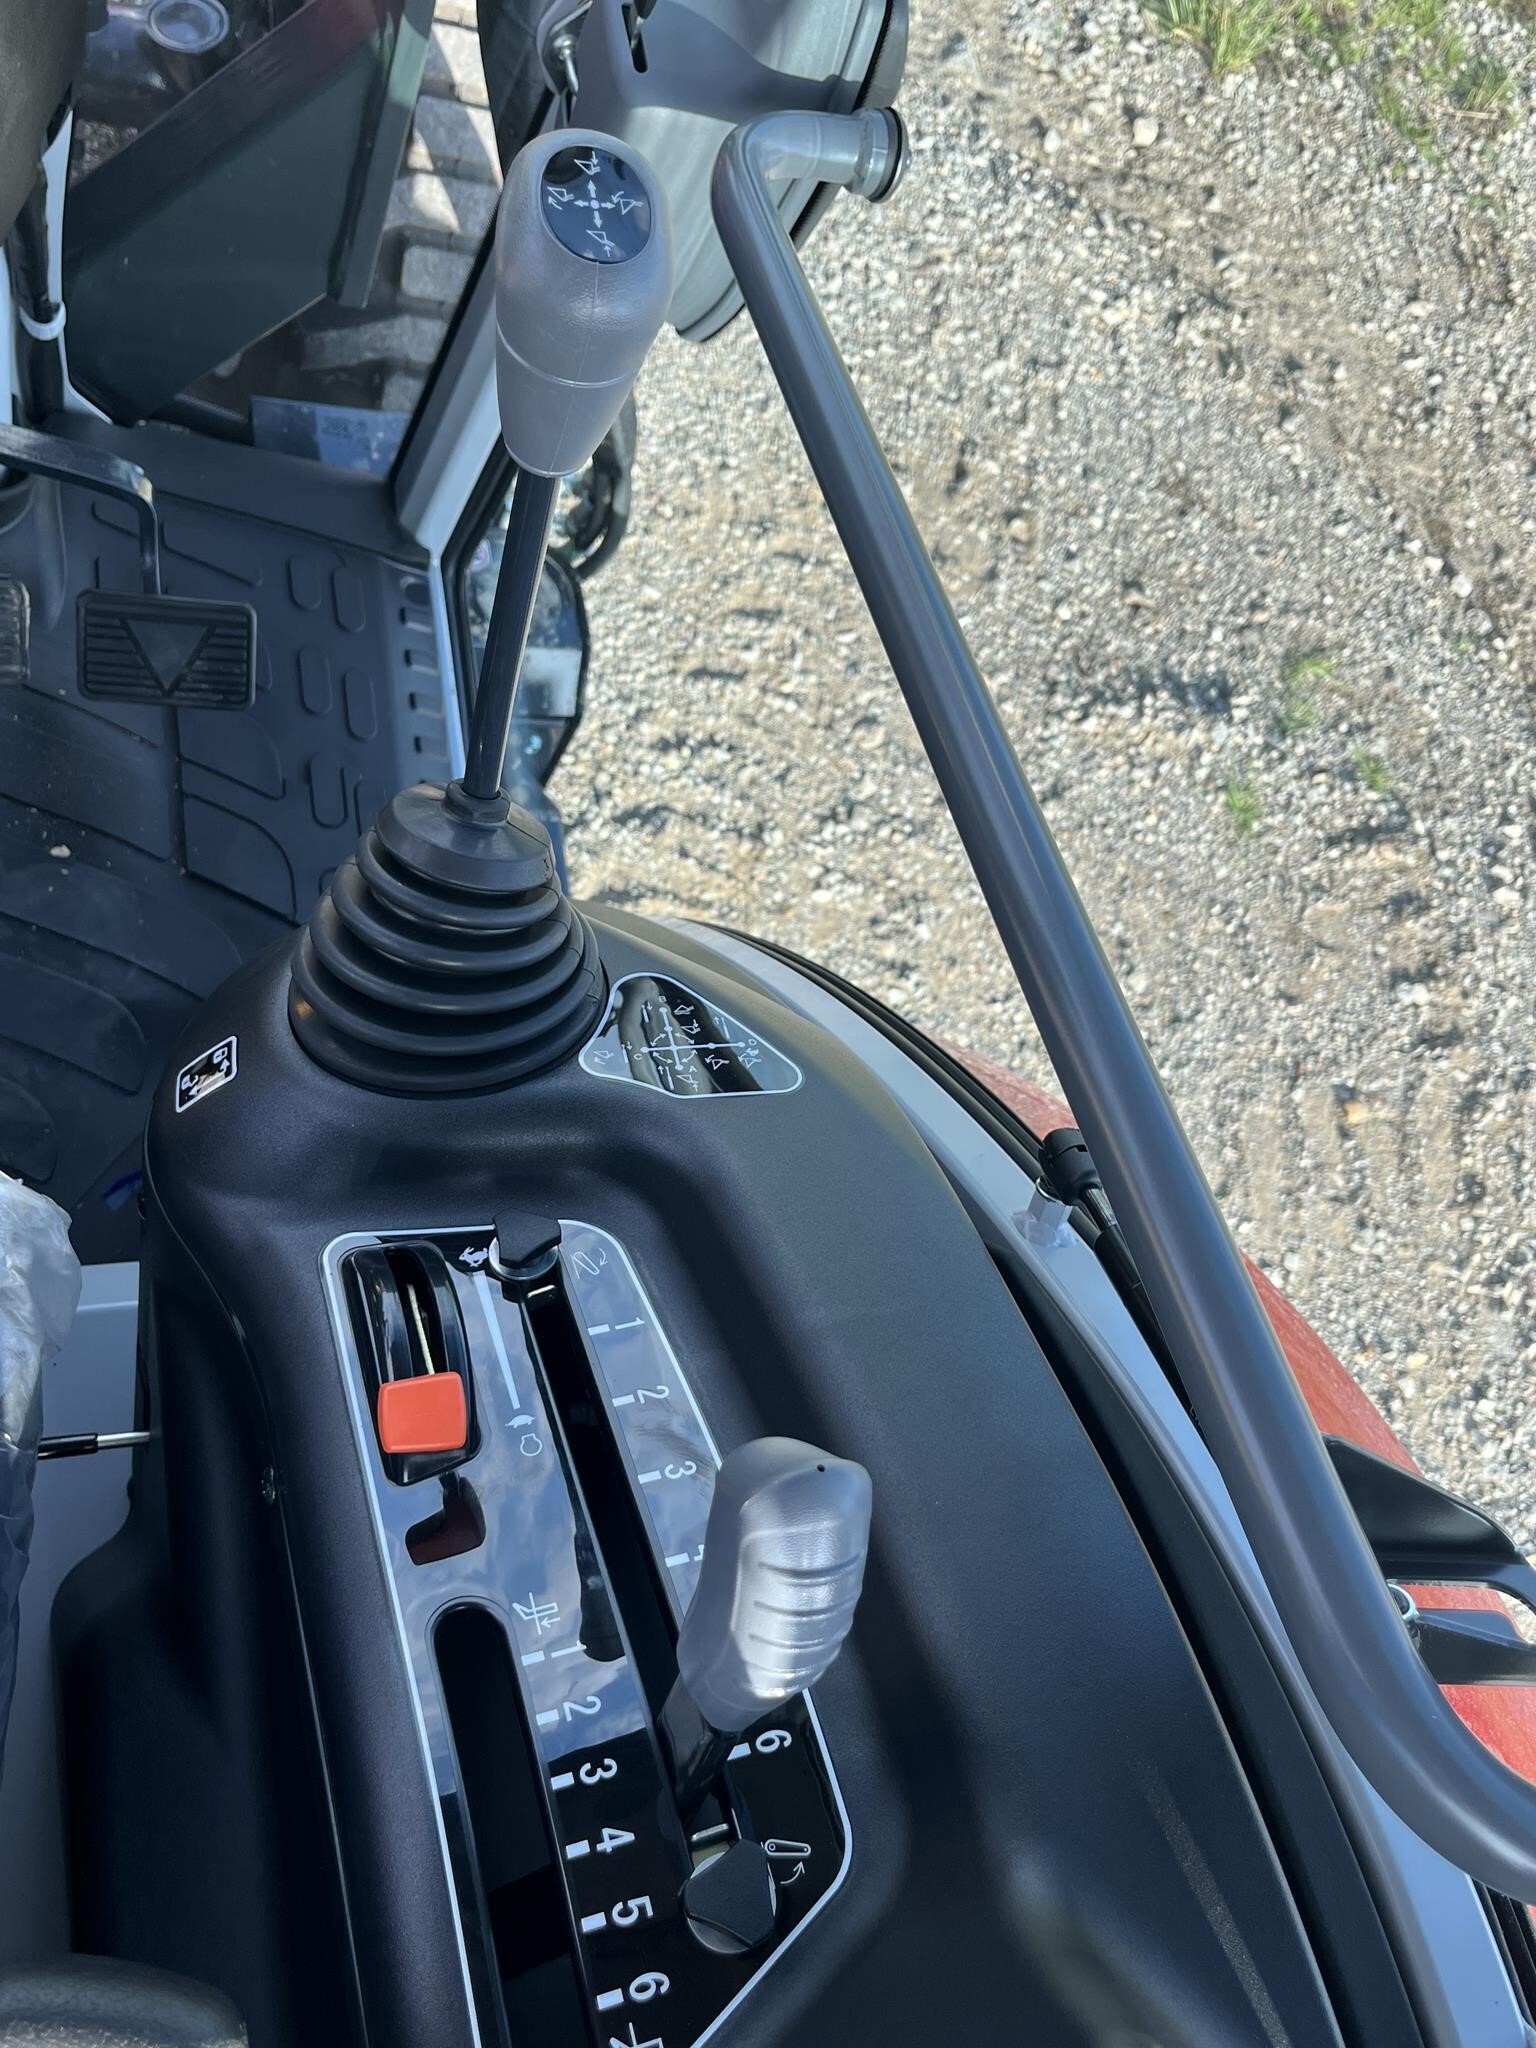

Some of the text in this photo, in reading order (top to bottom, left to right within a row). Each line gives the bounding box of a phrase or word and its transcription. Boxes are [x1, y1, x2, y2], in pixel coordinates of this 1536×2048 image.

[633, 1053, 643, 1061] C
[689, 1065, 698, 1073] A
[614, 1317, 644, 1330] 1
[637, 1385, 670, 1404] 2
[665, 1460, 696, 1481] 3
[551, 1641, 587, 1658] 1
[563, 1695, 602, 1722] 2
[755, 1729, 792, 1755] 6
[579, 1758, 618, 1785] 3
[596, 1827, 635, 1854] 4
[611, 1895, 654, 1926] 5
[629, 1971, 670, 2005] 6
